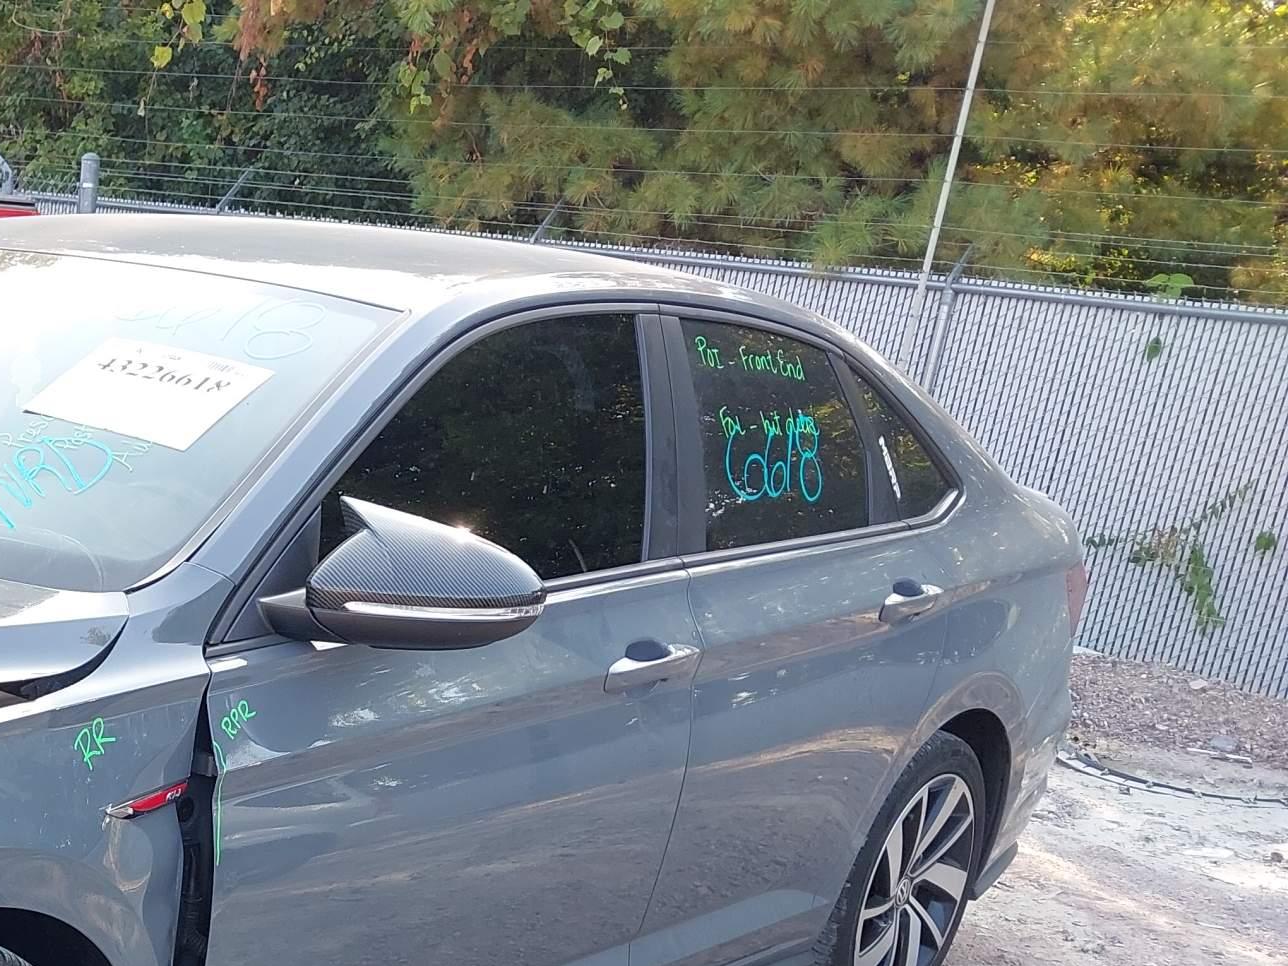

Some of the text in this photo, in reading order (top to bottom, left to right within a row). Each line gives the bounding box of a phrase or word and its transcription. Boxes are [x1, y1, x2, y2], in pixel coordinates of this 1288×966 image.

[97, 358, 231, 393] 43226618
[738, 345, 778, 374] Front
[776, 349, 807, 381] End
[725, 414, 823, 502] 6618
[73, 717, 116, 771] RR
